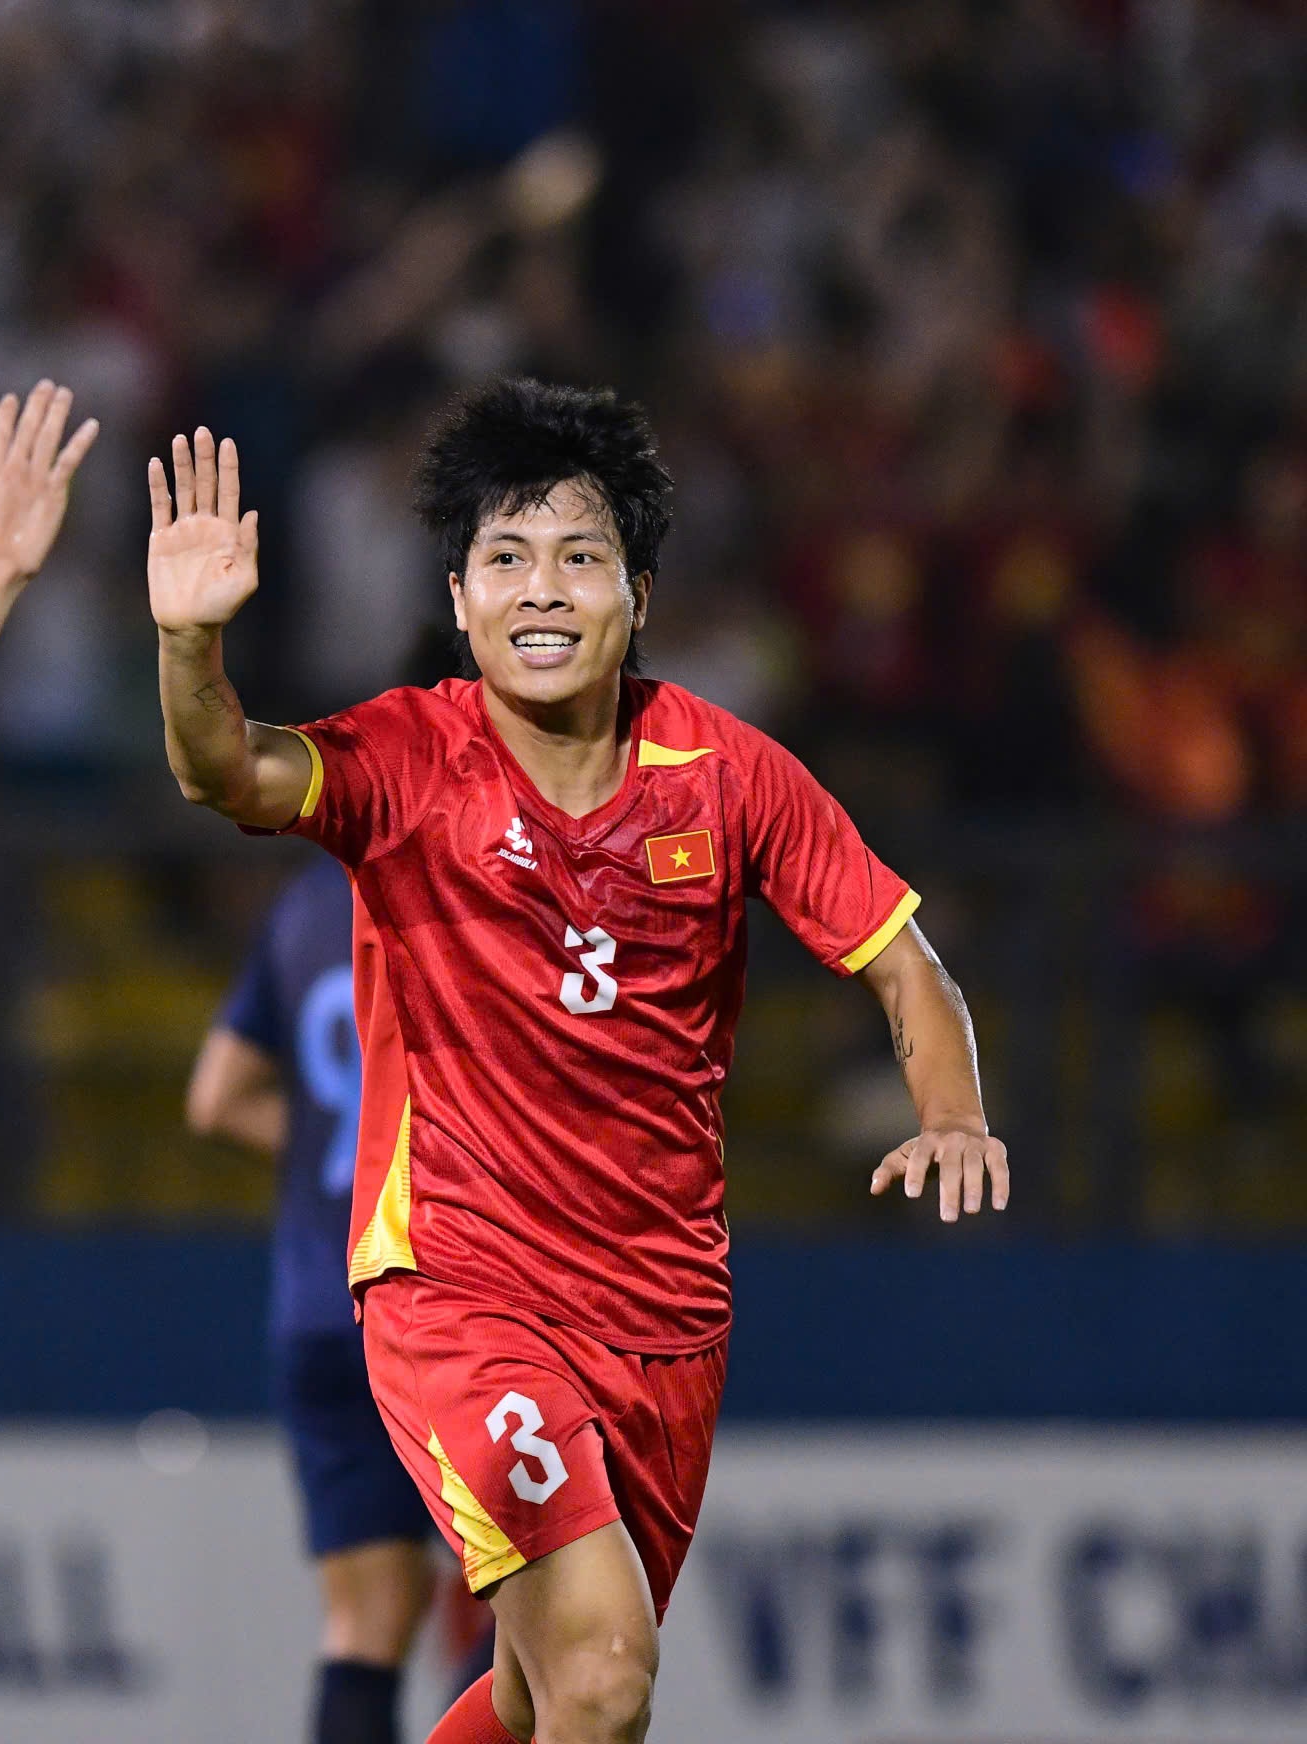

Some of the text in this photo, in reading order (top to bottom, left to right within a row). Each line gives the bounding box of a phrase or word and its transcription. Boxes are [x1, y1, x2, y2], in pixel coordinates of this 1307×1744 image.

[559, 924, 618, 1015] 3
[298, 964, 363, 1196] 9
[484, 1390, 569, 1505] 3
